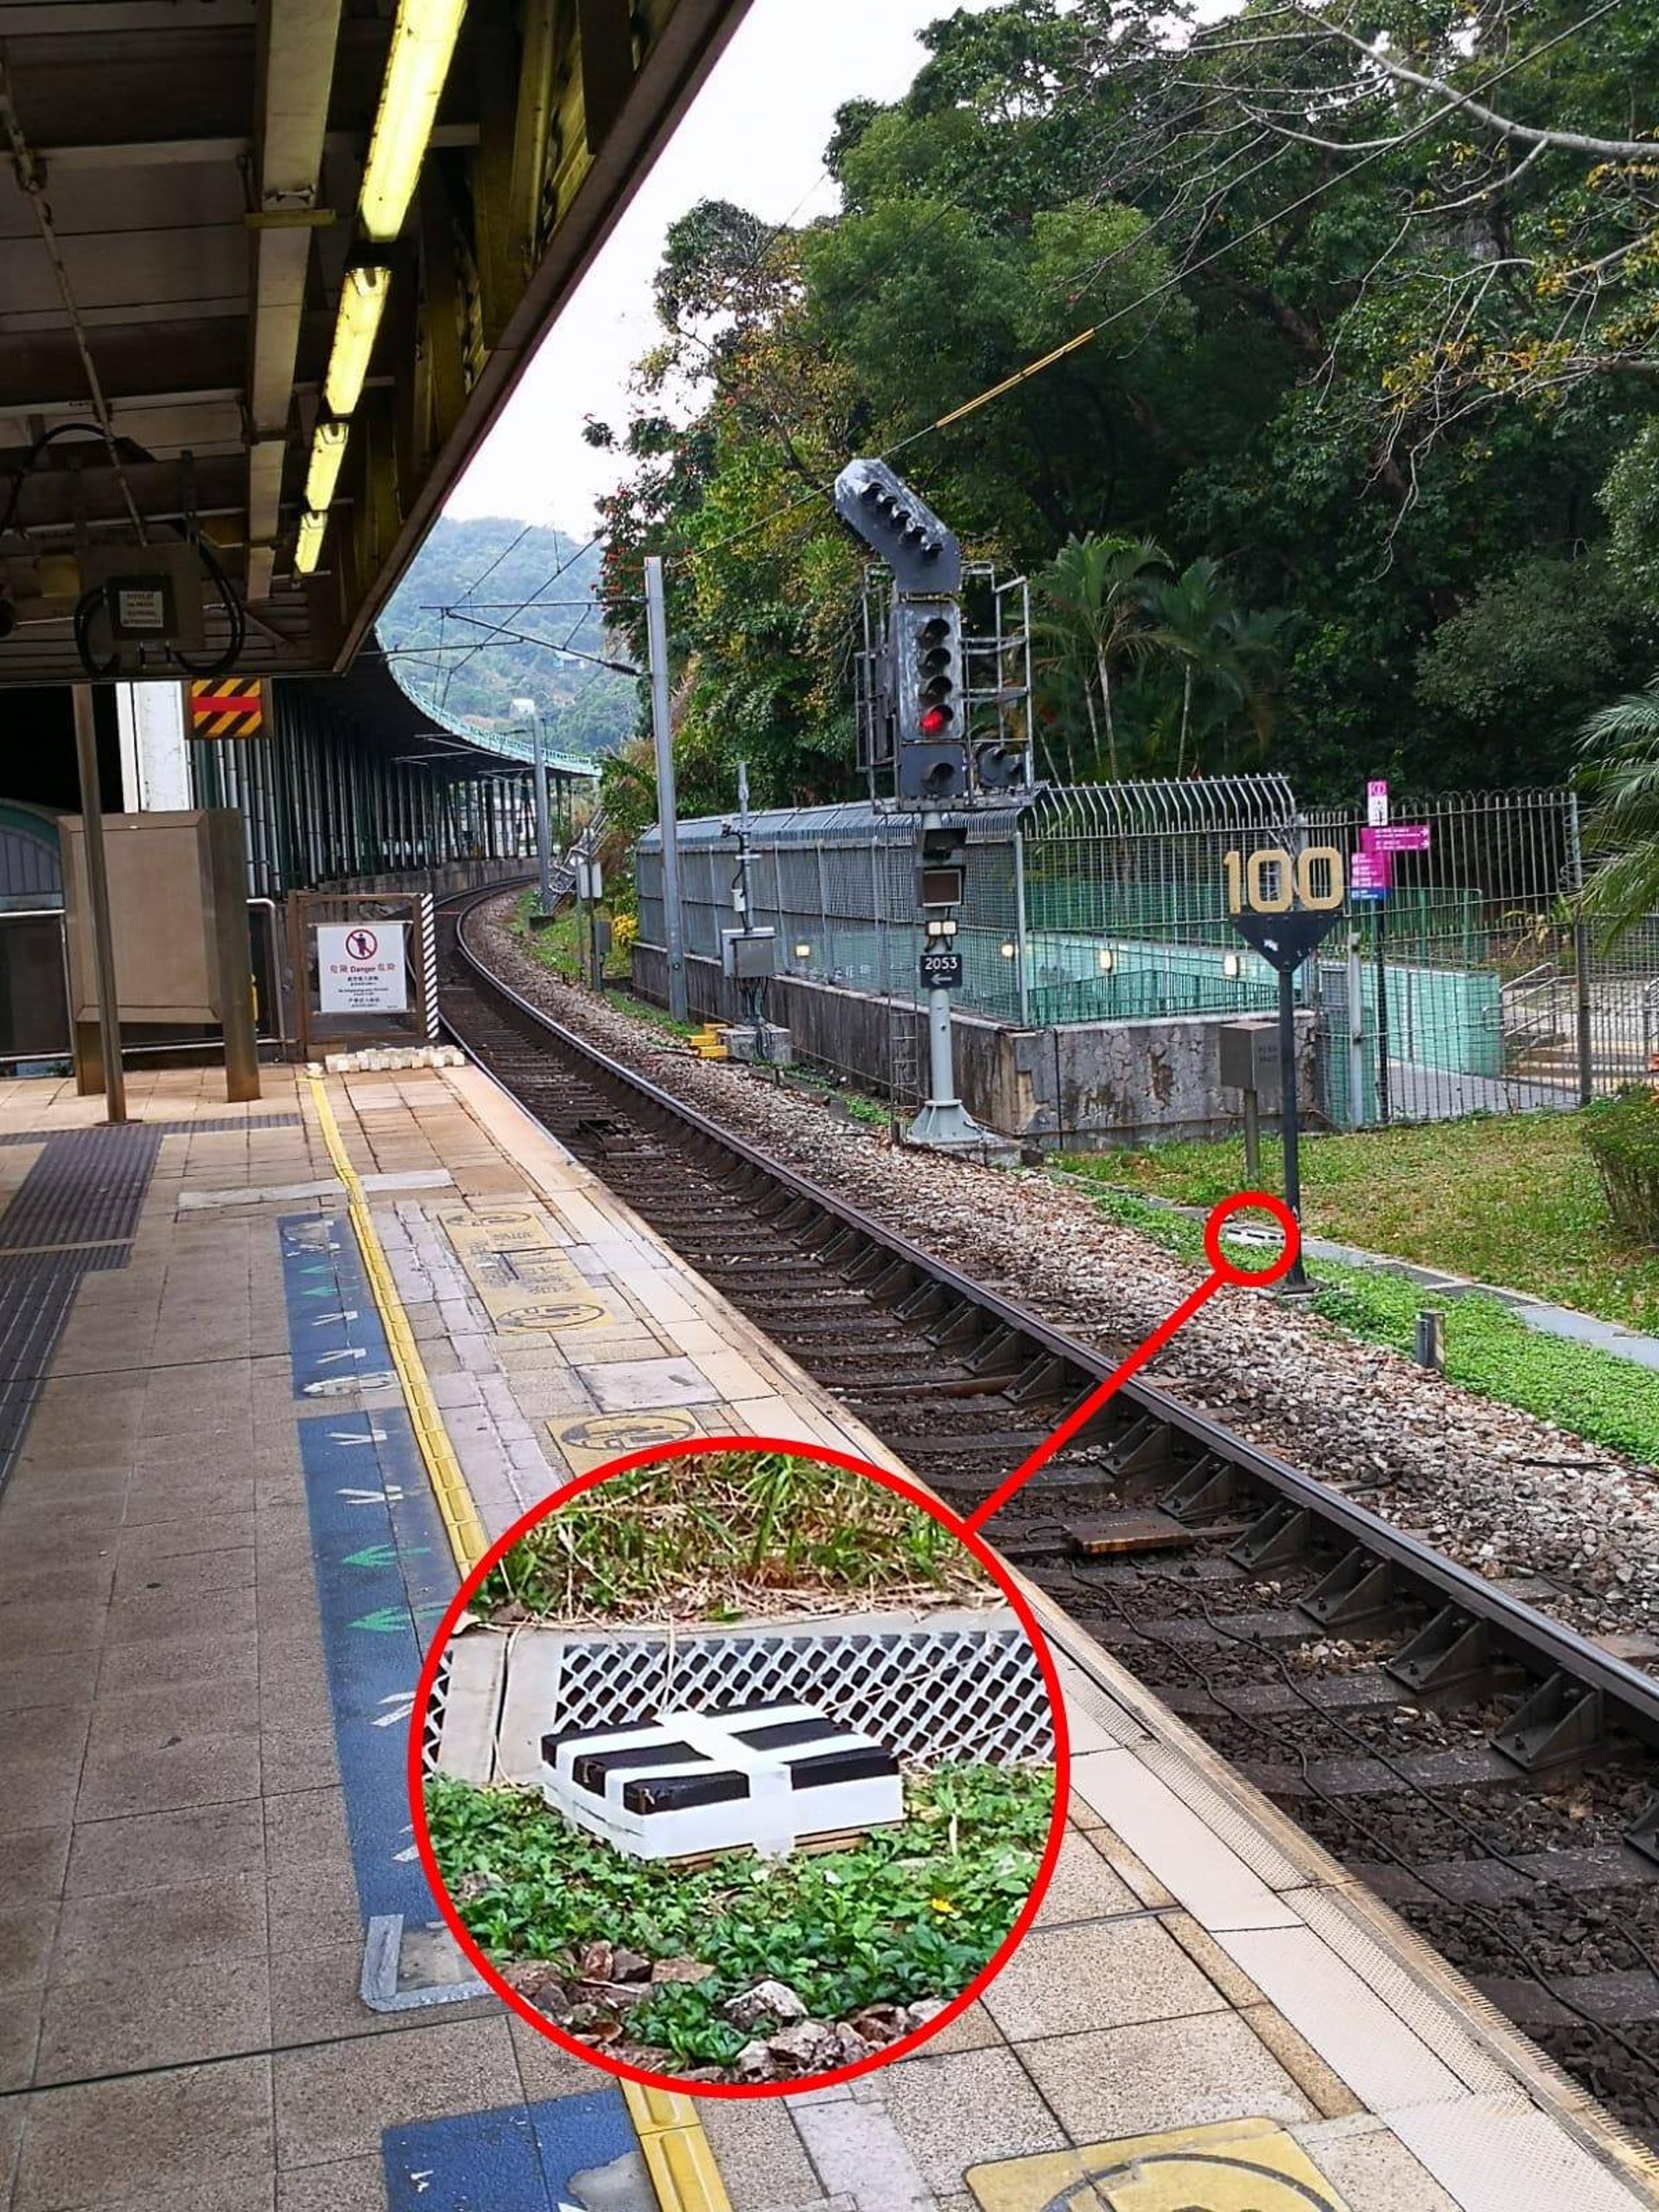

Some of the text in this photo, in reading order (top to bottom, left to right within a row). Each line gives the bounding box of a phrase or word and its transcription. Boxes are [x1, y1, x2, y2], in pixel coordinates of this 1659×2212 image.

[1224, 847, 1344, 915] 100
[925, 957, 957, 969] 2053
[350, 965, 376, 974] Danger
